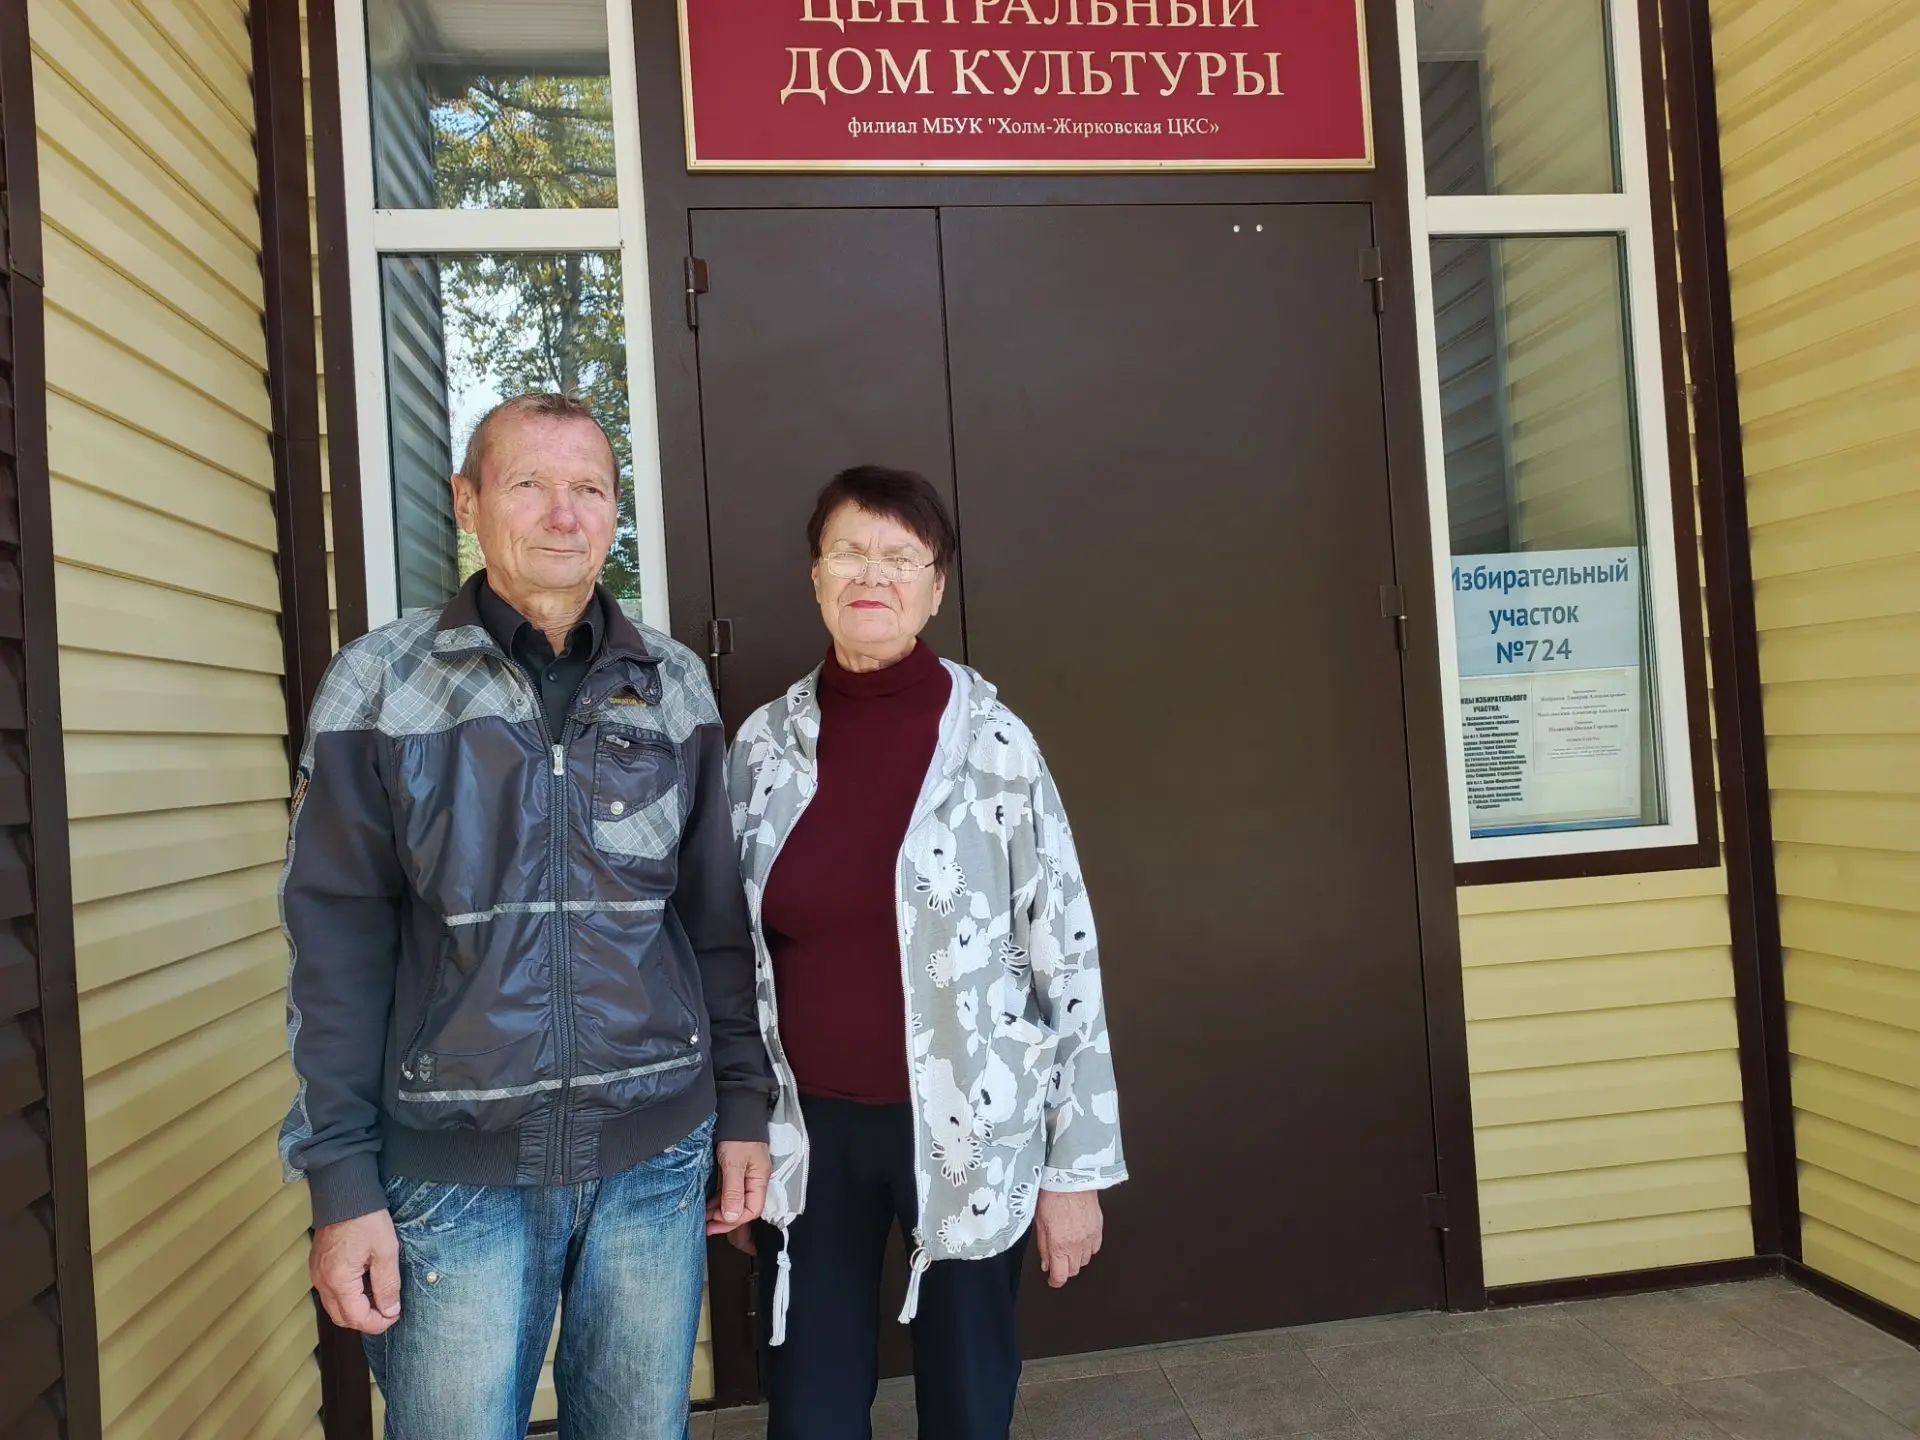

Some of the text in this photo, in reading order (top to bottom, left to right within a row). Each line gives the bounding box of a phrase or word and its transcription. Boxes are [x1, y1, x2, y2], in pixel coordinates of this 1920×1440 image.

[780, 47, 1284, 105] ДОМ КУЛЬТУРЫ
[848, 117, 917, 138] филиал
[923, 117, 982, 134] МБУК
[988, 118, 1162, 138] "Холм-Жирковская
[1452, 557, 1628, 595] Избирательный
[1489, 605, 1579, 634] участок
[1496, 638, 1572, 664] №724
